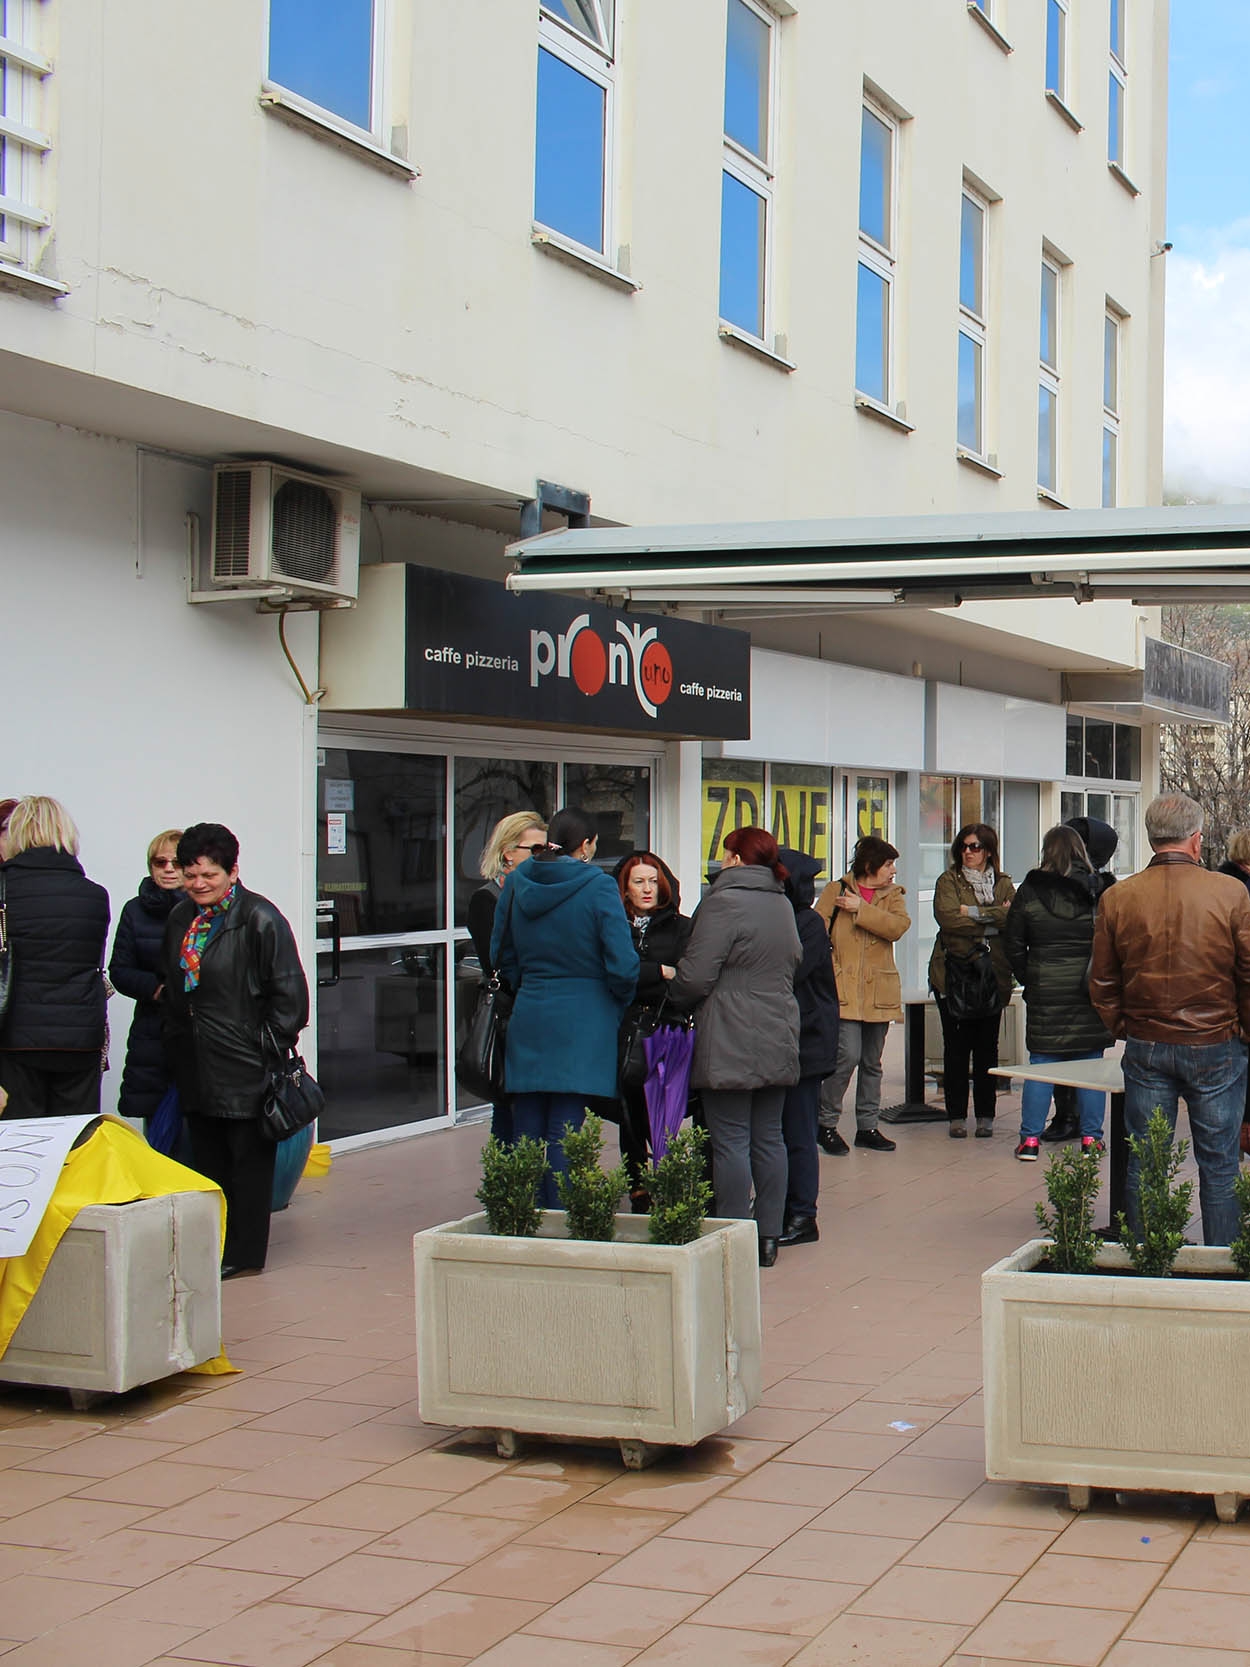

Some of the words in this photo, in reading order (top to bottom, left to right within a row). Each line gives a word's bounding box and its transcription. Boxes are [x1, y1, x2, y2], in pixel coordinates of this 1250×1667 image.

[424, 647, 462, 664] caffe
[465, 651, 520, 671] pizzeria
[644, 663, 671, 686] uno
[680, 682, 704, 697] caffe
[706, 685, 743, 702] pizzeria
